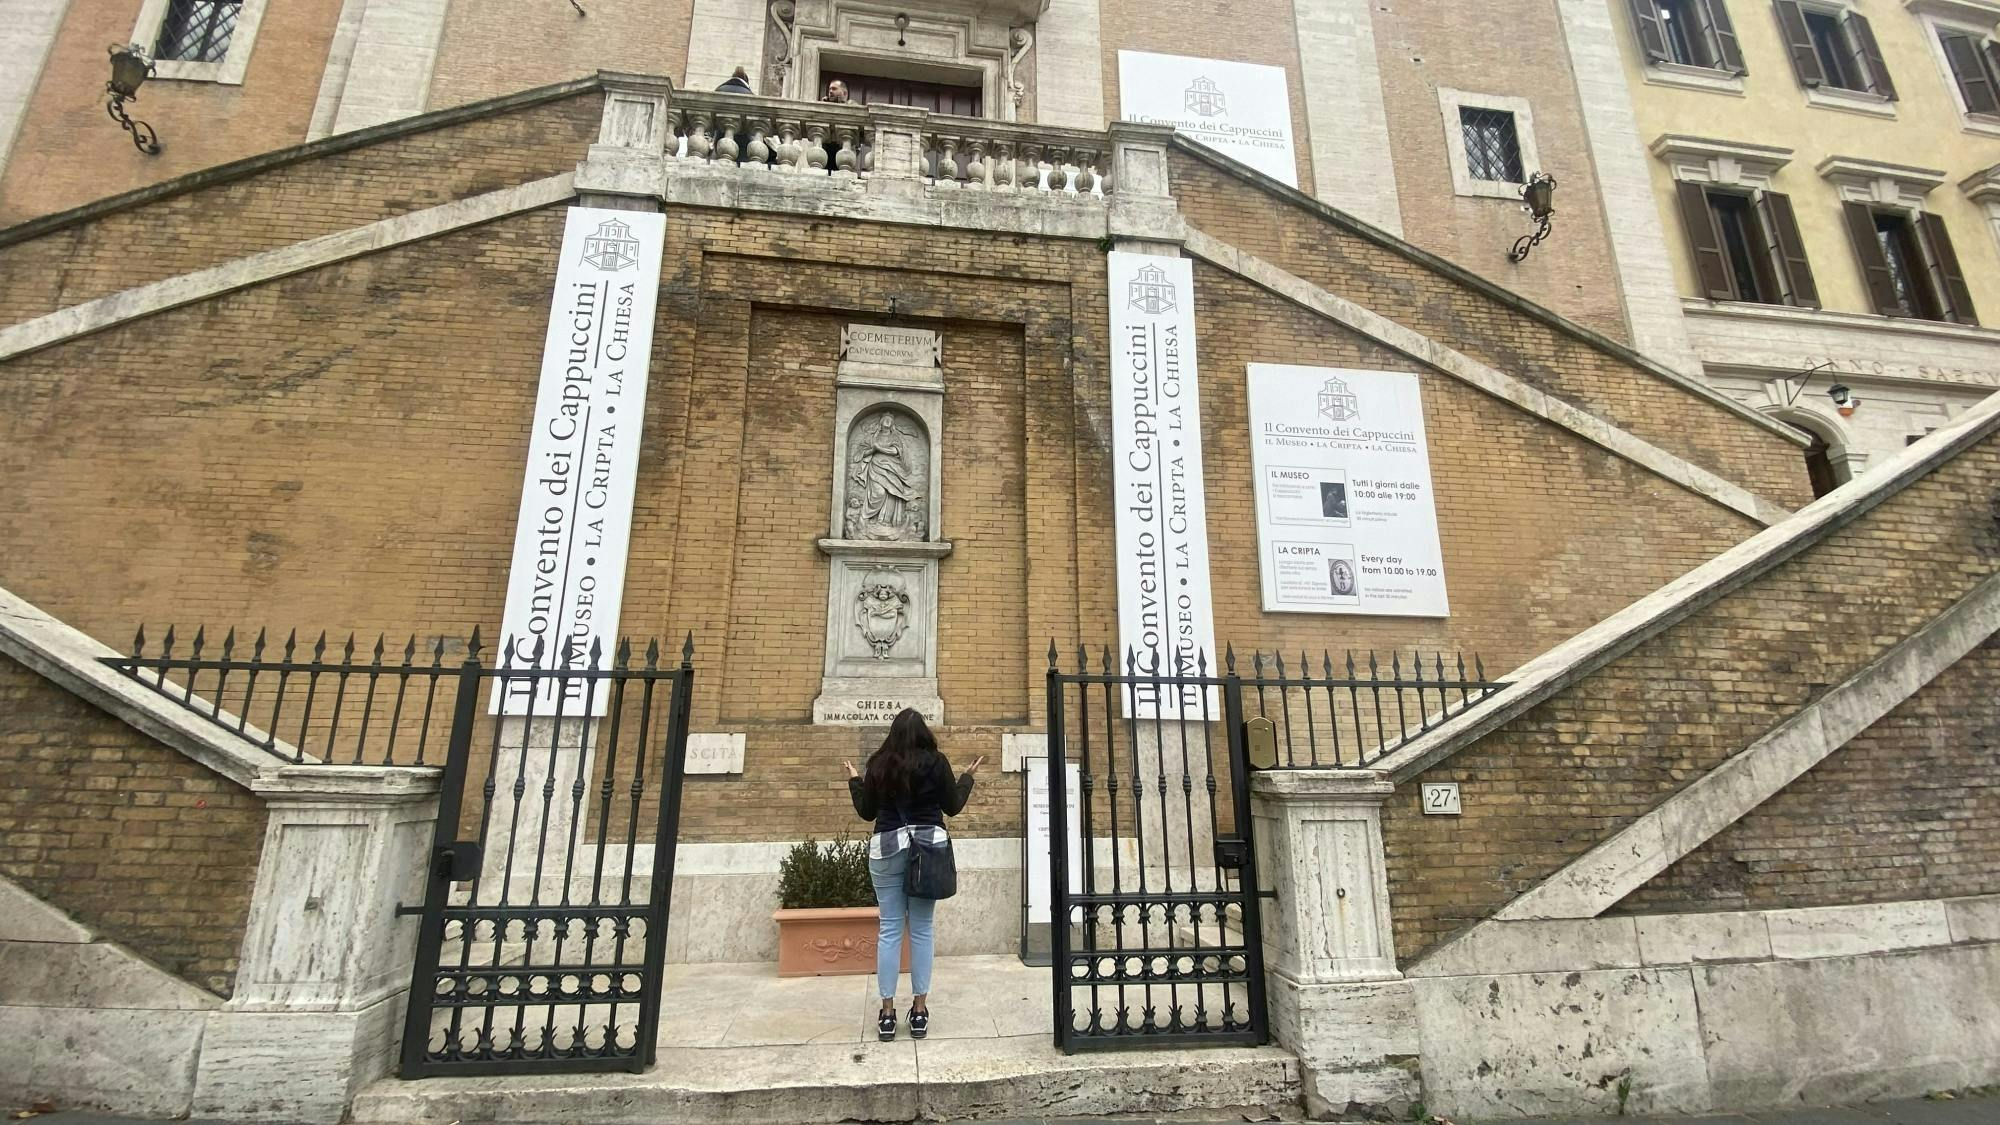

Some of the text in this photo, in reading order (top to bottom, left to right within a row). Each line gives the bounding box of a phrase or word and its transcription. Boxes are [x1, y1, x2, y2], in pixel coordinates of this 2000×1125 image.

[1199, 119, 1216, 131] dei
[1219, 123, 1283, 138] Cappuccini
[1195, 134, 1228, 144] CRIPTA
[1252, 140, 1285, 150] CHIESA
[606, 282, 635, 361] CHIESA
[850, 331, 932, 347] COEMETERIVM
[549, 282, 597, 441] Cappuccini
[1163, 325, 1181, 398] CHIESA
[606, 369, 624, 396] LA
[1126, 324, 1157, 472] Cappuccini
[1169, 405, 1182, 430] LA
[1264, 422, 1415, 442] Il Convento dei Cappuccini
[1276, 438, 1308, 447] MUSEO
[1330, 441, 1362, 451] CRIPTA
[1385, 444, 1417, 453] CHIESA
[539, 451, 572, 496] dei
[585, 424, 616, 509] CRIPTA
[1280, 471, 1310, 480] MUSEO
[1169, 456, 1186, 534] CRIPTA
[1375, 481, 1398, 489] giorni
[1400, 482, 1420, 490] dalle
[1130, 482, 1153, 522] dei
[585, 518, 604, 548] LA
[1176, 542, 1189, 569] LA
[1278, 546, 1321, 555] LA CRIPTA
[1361, 555, 1402, 565] Every day
[1362, 566, 1381, 574] from
[1406, 568, 1414, 576] to
[857, 701, 902, 710] CHIESA
[824, 713, 879, 721] IMMACOLATA
[690, 747, 738, 760] SCITA
[1431, 788, 1451, 807] 27
